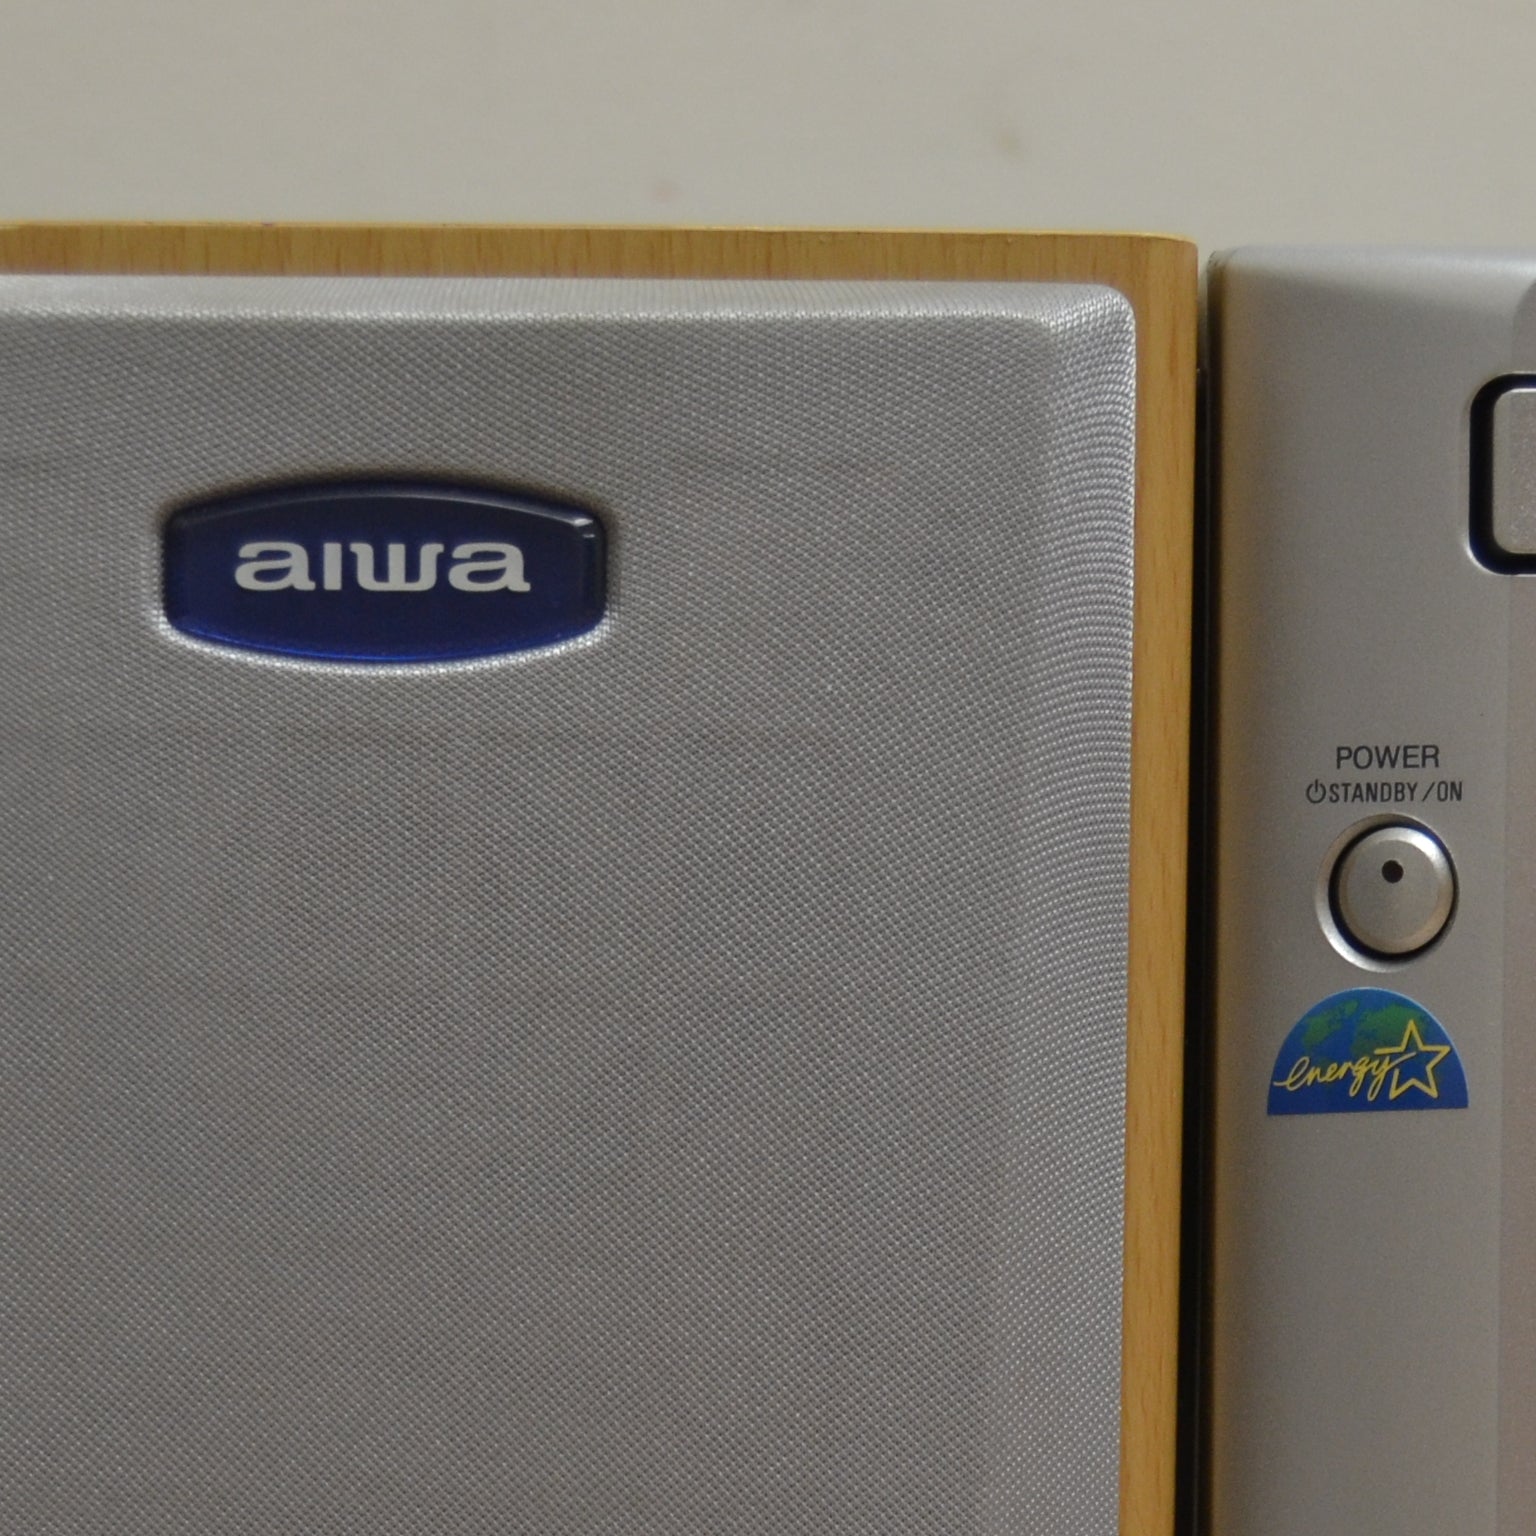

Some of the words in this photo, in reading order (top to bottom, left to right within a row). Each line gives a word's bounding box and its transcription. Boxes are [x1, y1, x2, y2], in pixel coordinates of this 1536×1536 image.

[234, 540, 531, 592] aiwa
[1335, 744, 1441, 770] POWER
[1273, 1052, 1416, 1102] energy
